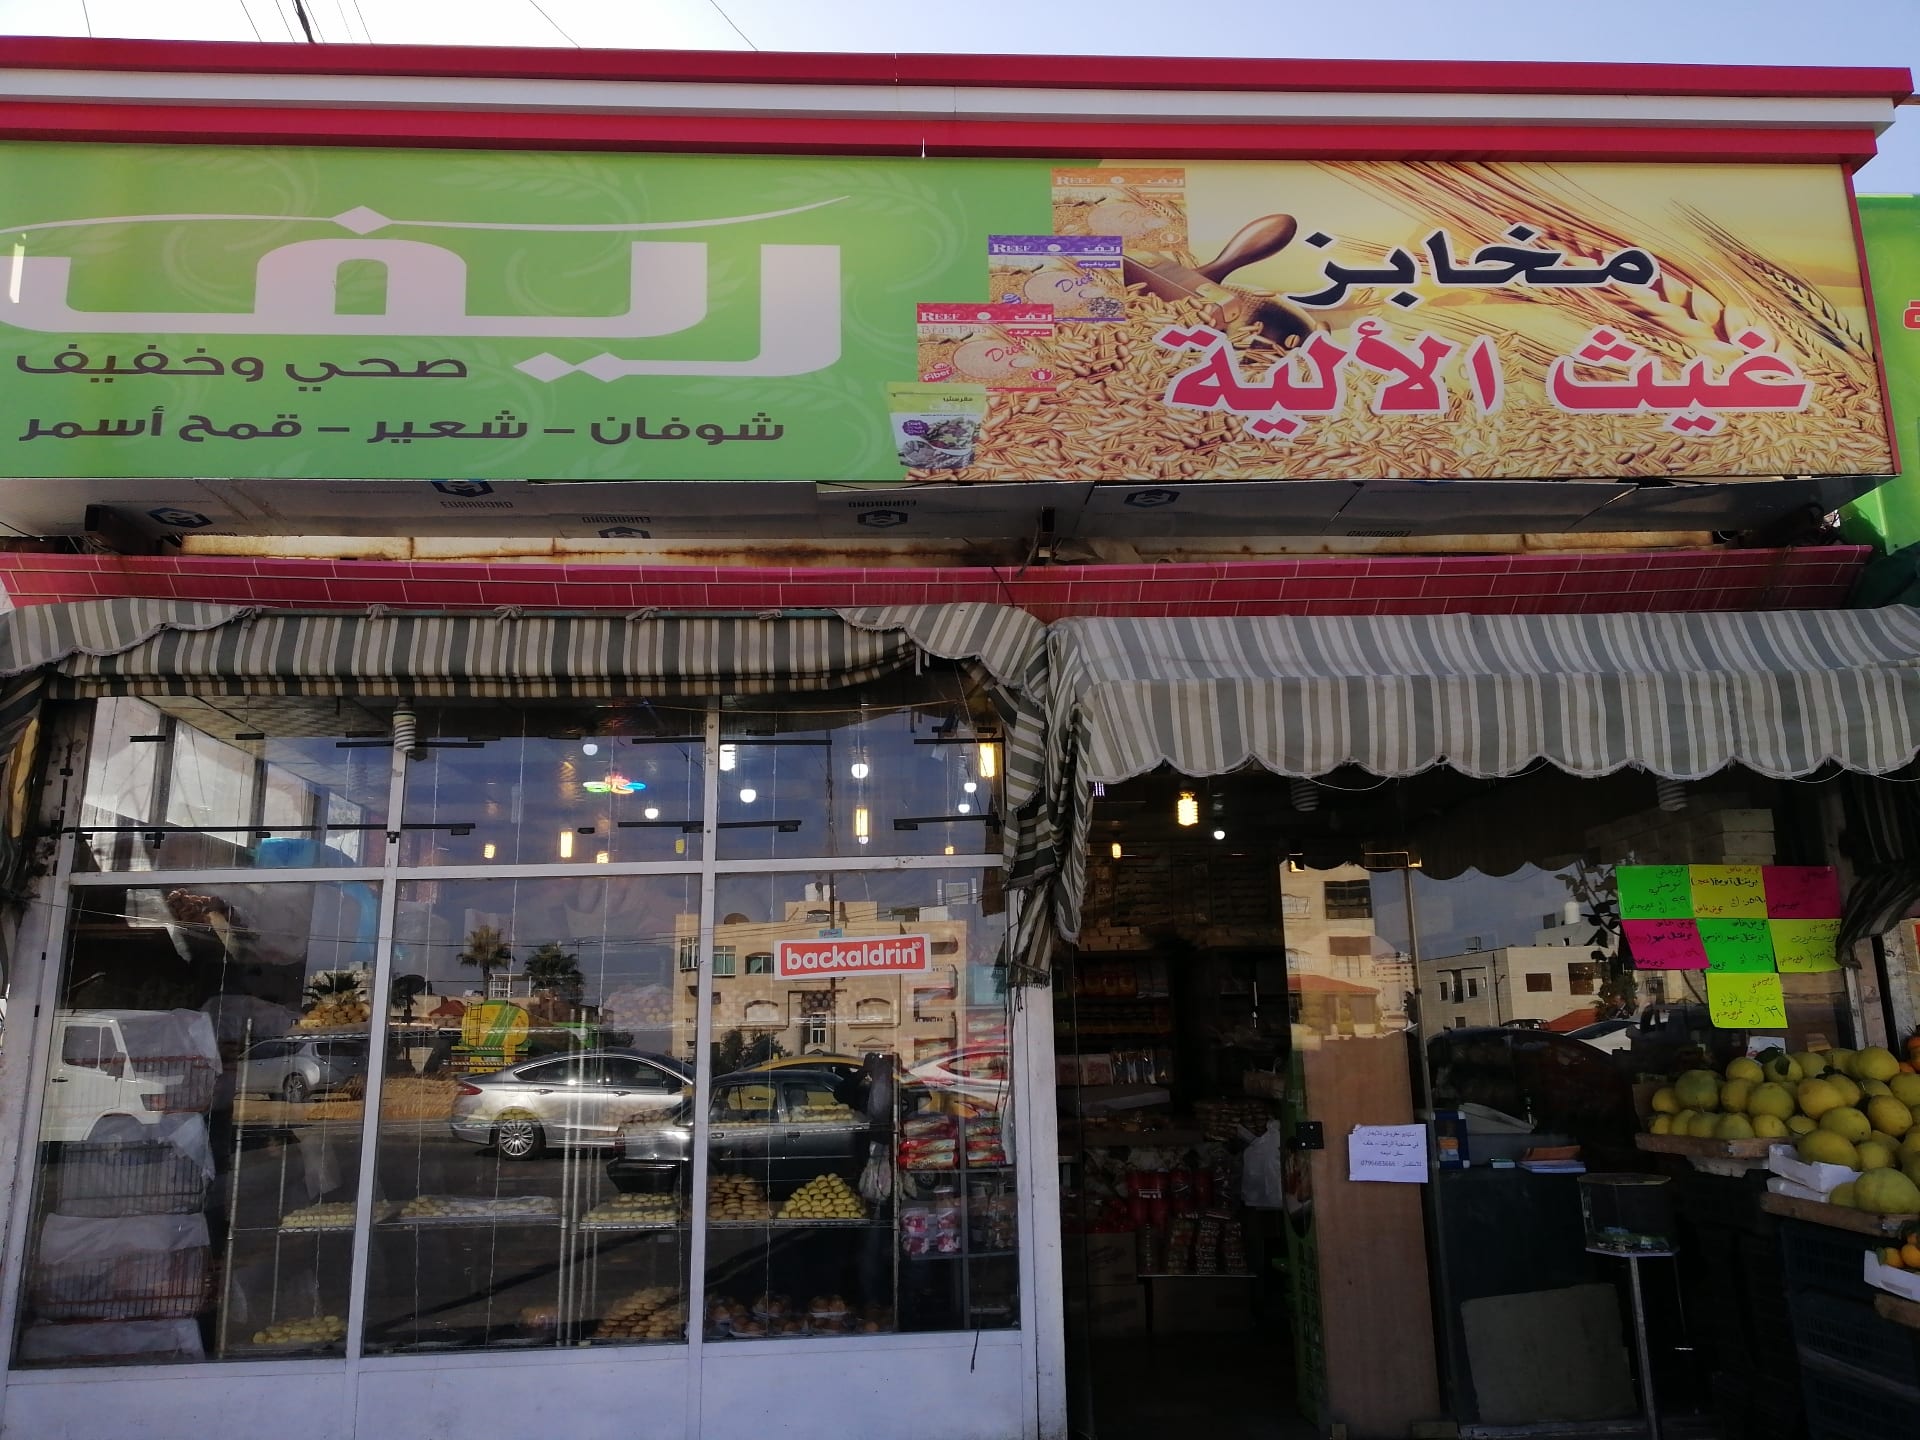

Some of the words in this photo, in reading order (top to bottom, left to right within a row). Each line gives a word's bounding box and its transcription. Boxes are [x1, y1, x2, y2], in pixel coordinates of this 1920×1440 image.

[992, 244, 1031, 253] REEF
[1286, 223, 1658, 310] مخابز
[921, 312, 961, 321] REEF
[16, 343, 264, 383] وخفيف
[285, 356, 468, 392] صحي
[923, 369, 951, 382] Fiber
[1546, 326, 1812, 436] غيث
[18, 405, 164, 442] أسمر
[178, 413, 303, 442] قمح
[366, 410, 529, 444] شعير
[590, 410, 785, 446] شوفان
[786, 942, 918, 970] backaldrin
